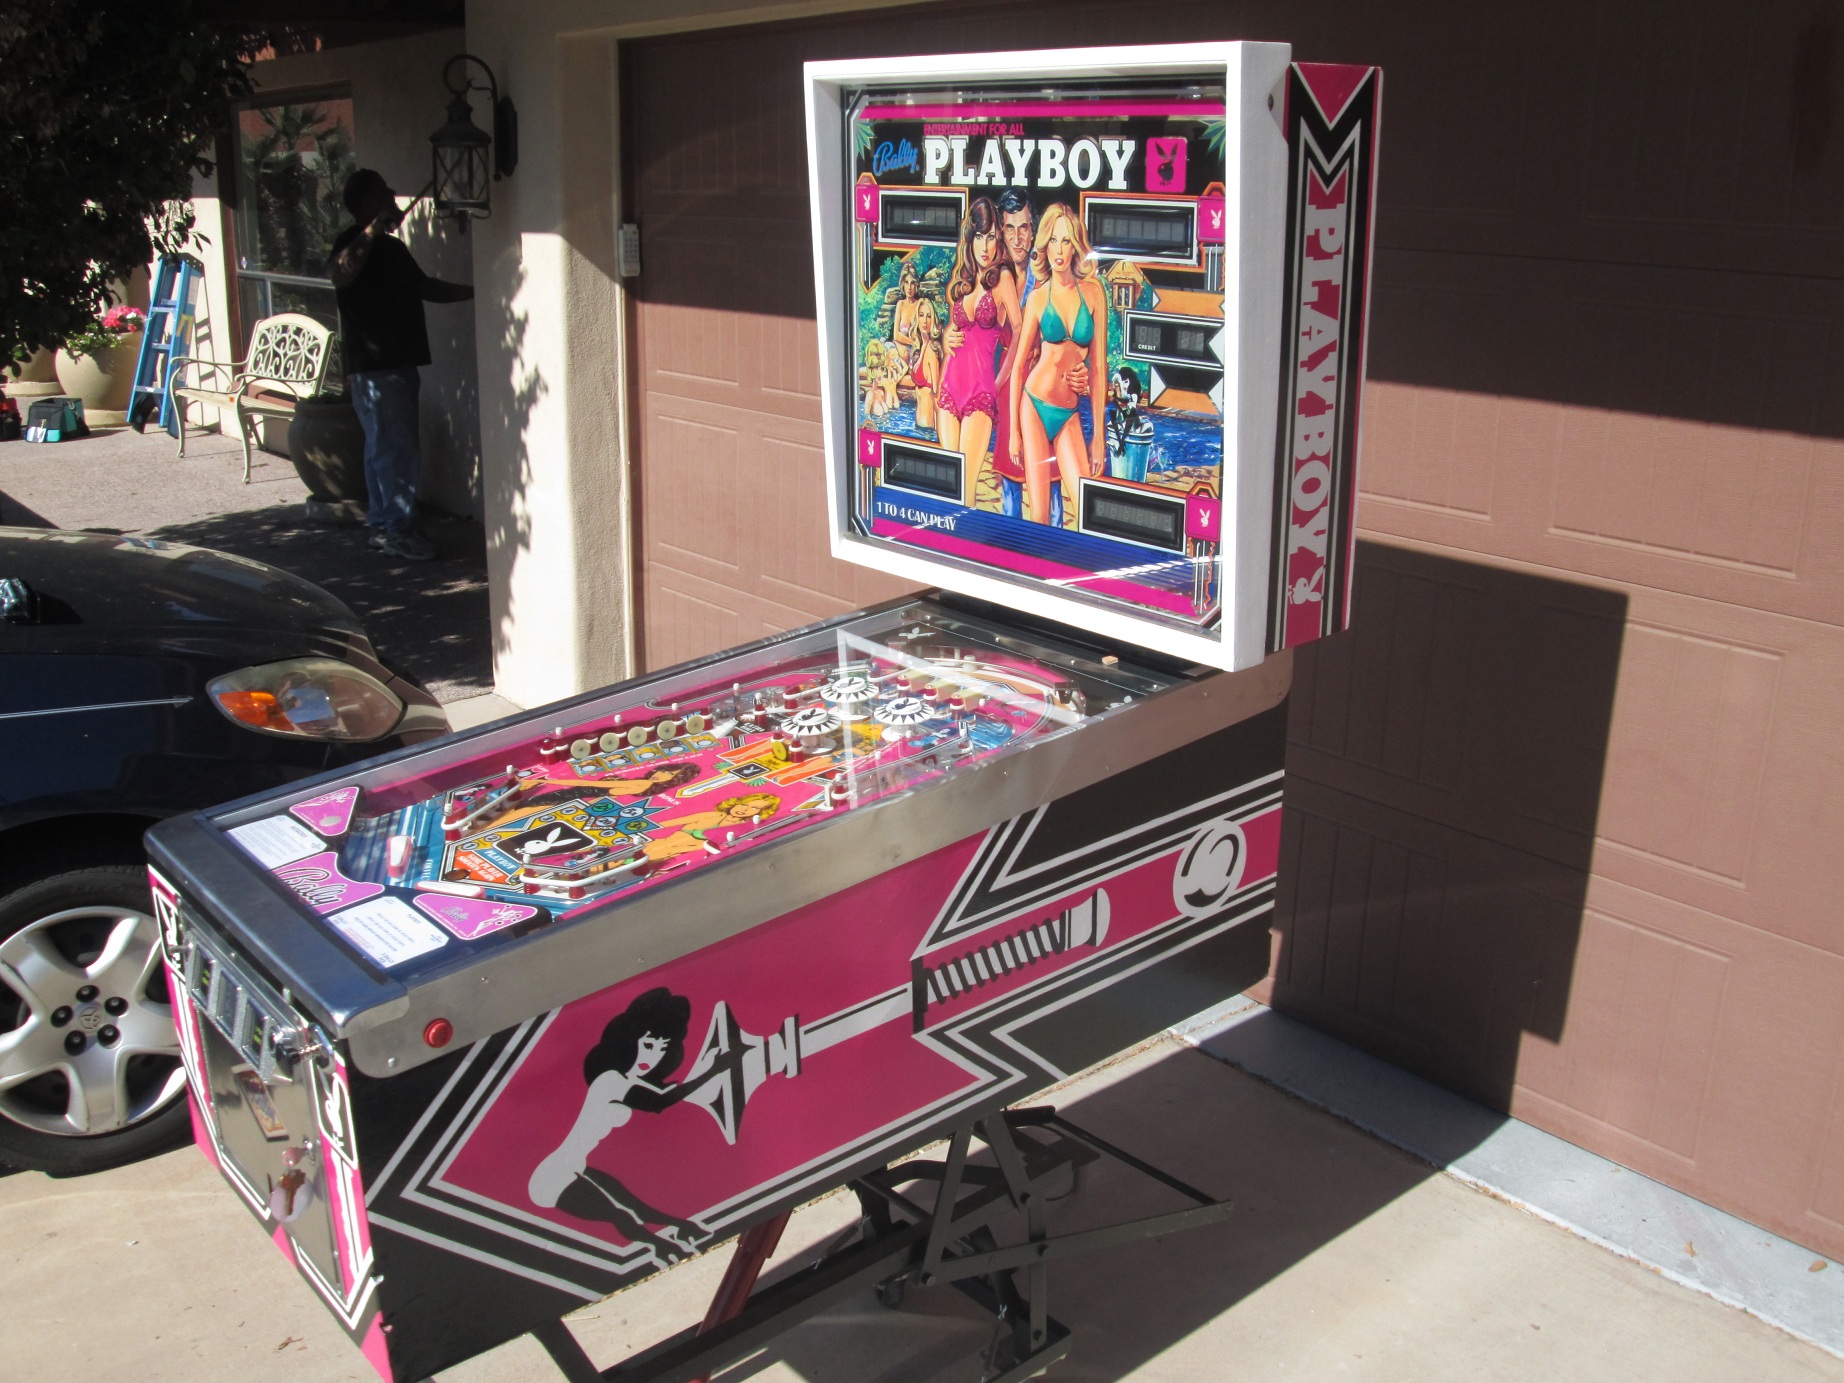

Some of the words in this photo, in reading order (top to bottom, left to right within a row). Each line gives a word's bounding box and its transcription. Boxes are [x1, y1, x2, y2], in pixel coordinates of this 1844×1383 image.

[924, 123, 987, 136] ENTERTAINMENT
[989, 124, 1007, 136] FOR
[1009, 124, 1025, 136] ALL
[872, 138, 919, 176] Bally
[924, 138, 1136, 190] PLAYBOY
[1289, 203, 1346, 558] PLAYBOY
[876, 502, 882, 513] 1
[883, 503, 898, 517] TO
[899, 507, 906, 519] 4
[907, 509, 928, 524] CAN
[929, 513, 957, 531] PLAY
[484, 849, 517, 870] PLAYBOY
[276, 866, 348, 907] Bally
